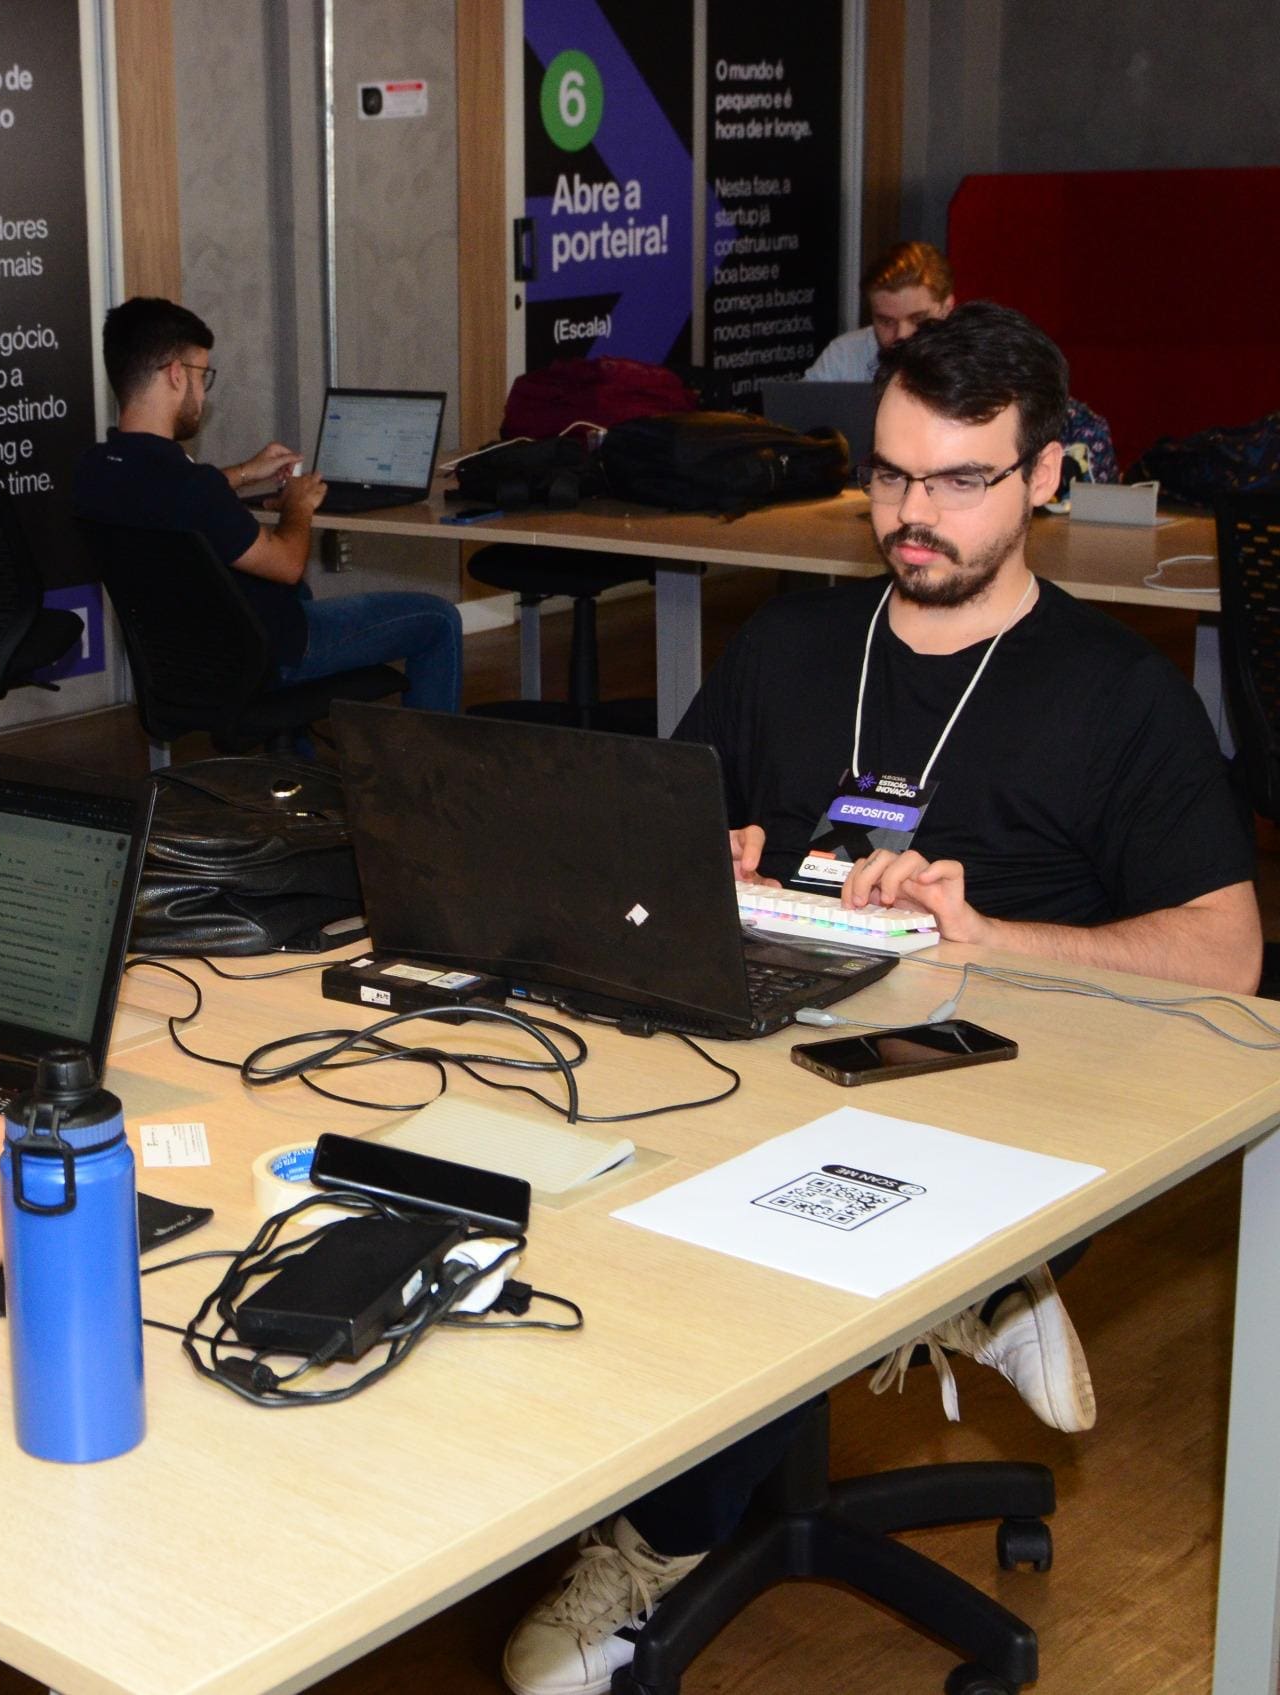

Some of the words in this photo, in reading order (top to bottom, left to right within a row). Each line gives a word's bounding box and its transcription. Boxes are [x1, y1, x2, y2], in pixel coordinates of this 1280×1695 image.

[5, 63, 33, 91] de
[715, 59, 727, 81] O
[728, 60, 773, 80] mundo
[775, 59, 784, 80] é
[559, 70, 586, 127] 6
[715, 92, 772, 114] pequeno
[773, 92, 782, 109] e
[715, 119, 745, 140] hora
[746, 118, 762, 139] de
[764, 117, 773, 137] ir
[774, 117, 813, 141] longe.
[551, 173, 620, 216] Abre
[624, 179, 641, 211] a
[715, 177, 752, 197] Nesta
[714, 206, 758, 228] startup
[551, 214, 668, 273] porteira!
[714, 235, 771, 257] construiu
[772, 233, 799, 251] uma
[713, 265, 738, 286] boa
[739, 263, 769, 283] base
[713, 293, 764, 315] começa
[774, 287, 815, 307] buscar
[554, 313, 612, 344] (Escala)
[713, 321, 751, 342] novos
[713, 345, 796, 371] investimentos
[11, 368, 23, 387] a
[19, 439, 33, 458] e
[8, 471, 55, 495] time.
[840, 804, 905, 822] EXPOSITOR
[835, 1167, 859, 1178] ME
[859, 1173, 898, 1188] SCAN
